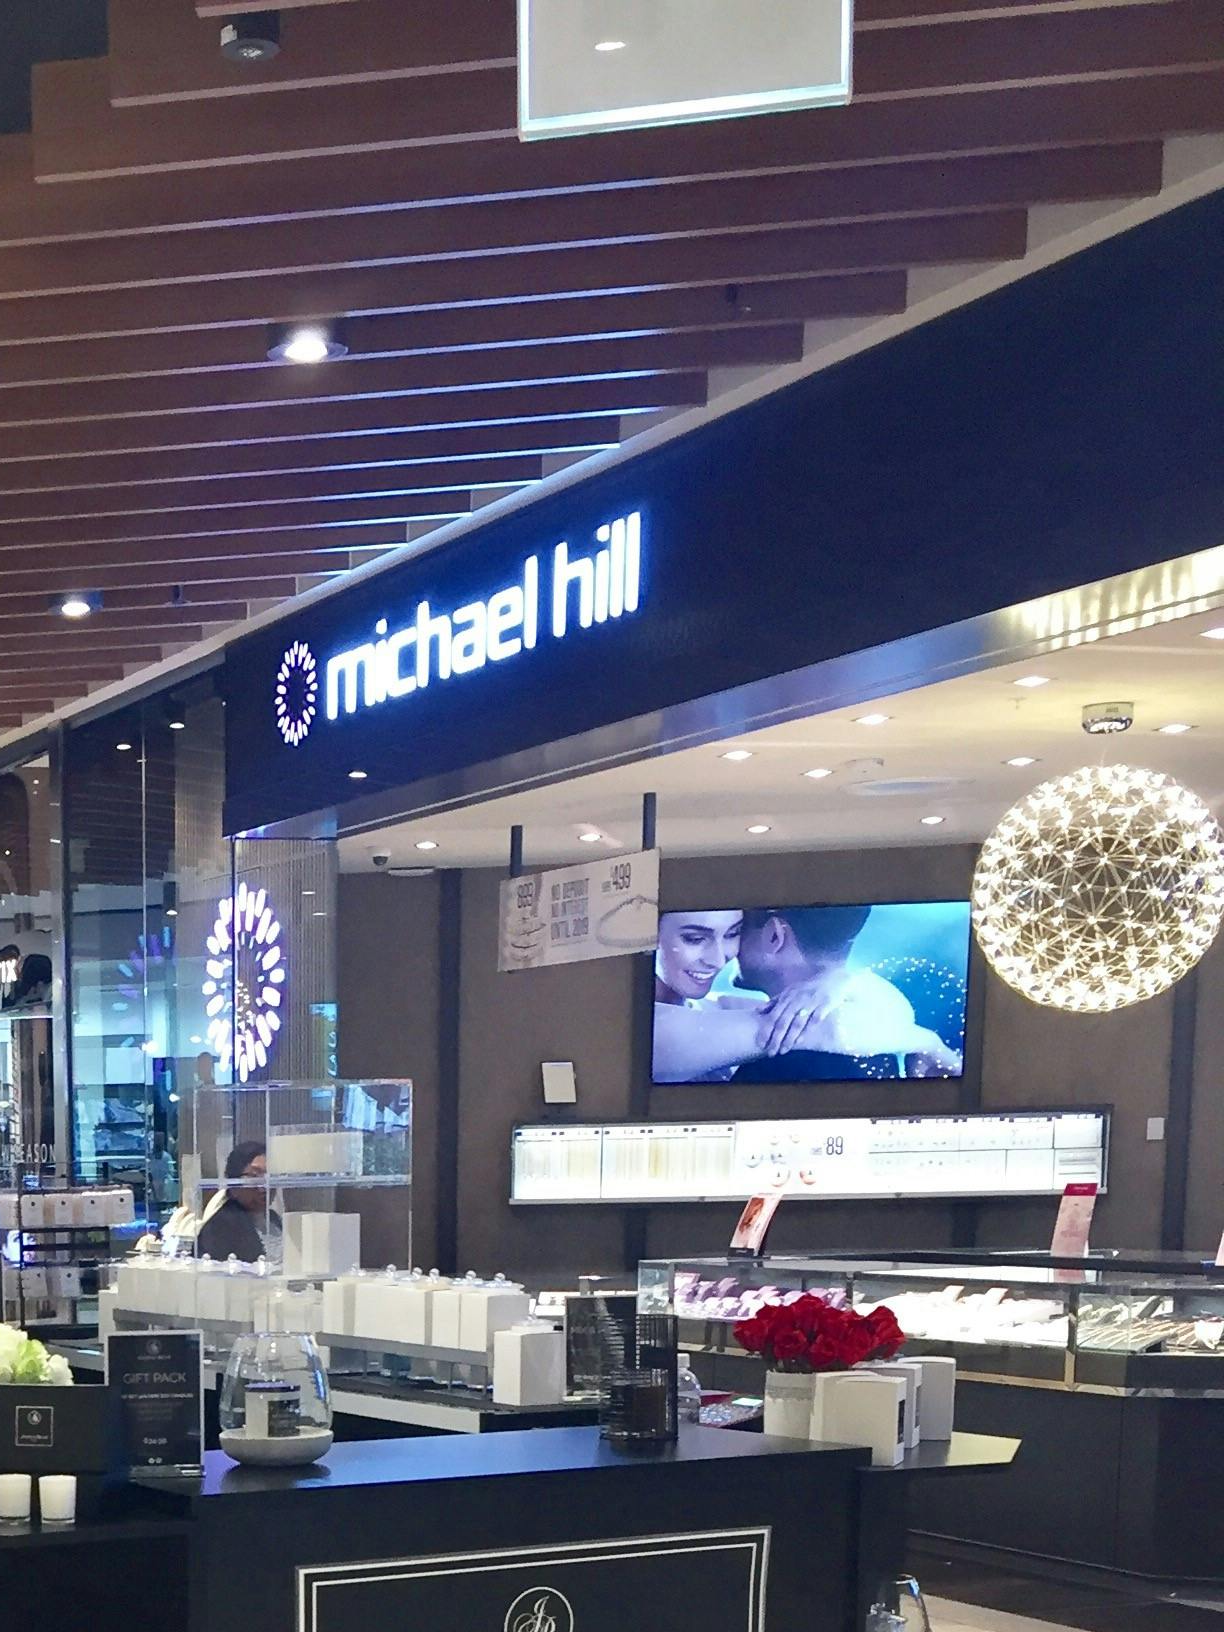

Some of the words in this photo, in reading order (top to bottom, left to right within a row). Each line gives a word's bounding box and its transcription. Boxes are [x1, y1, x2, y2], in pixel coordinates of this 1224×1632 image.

[326, 555, 538, 720] michael
[552, 511, 641, 638] hill
[122, 1372, 150, 1384] GIFT
[152, 1371, 187, 1383] PACK
